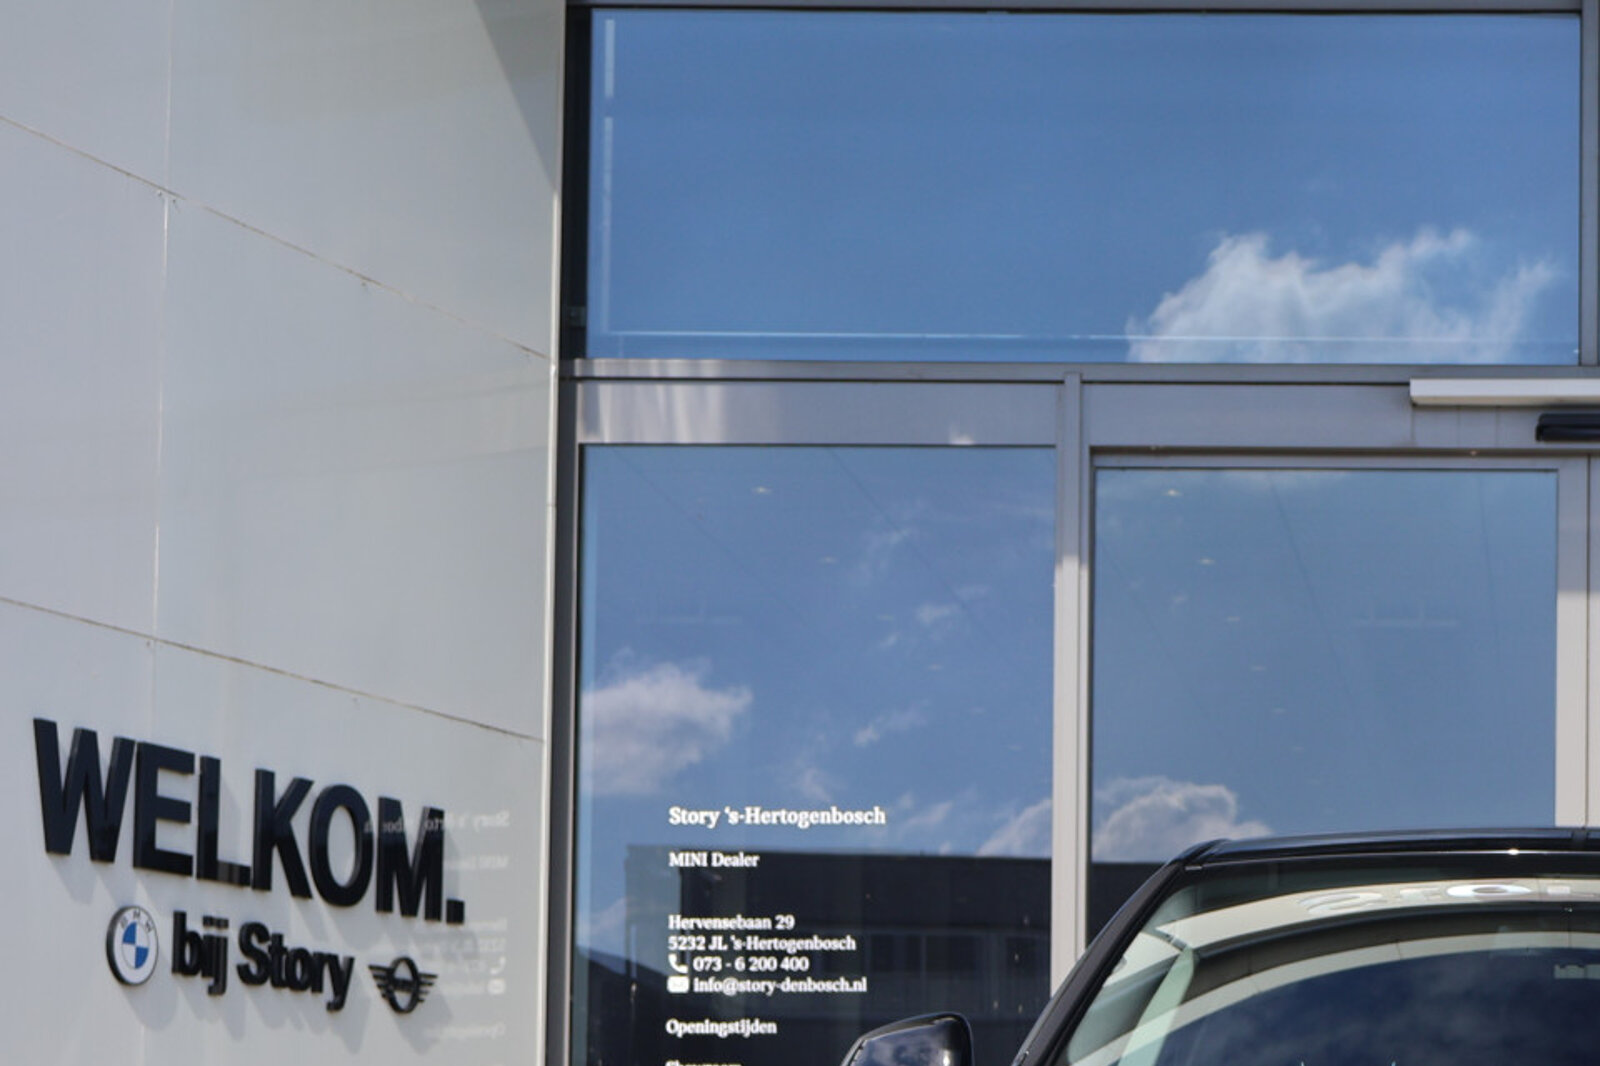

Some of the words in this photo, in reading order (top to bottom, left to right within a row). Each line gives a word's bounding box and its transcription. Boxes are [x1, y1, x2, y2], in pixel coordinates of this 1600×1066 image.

[33, 717, 465, 925] WELKOM.
[668, 806, 721, 829] Story
[668, 851, 708, 868] MINI
[711, 851, 760, 868] Dealer
[667, 913, 772, 931] Hervensebaan
[775, 913, 795, 931] 29
[667, 934, 706, 951] 5232
[708, 935, 728, 951] JL
[236, 921, 356, 1013] Story
[692, 956, 723, 972] 073
[734, 956, 746, 972] 6
[748, 956, 778, 972] 200
[780, 956, 810, 972] 400
[693, 976, 868, 996] info@story-denbosch.nl
[665, 1018, 778, 1037] Openingstijden
